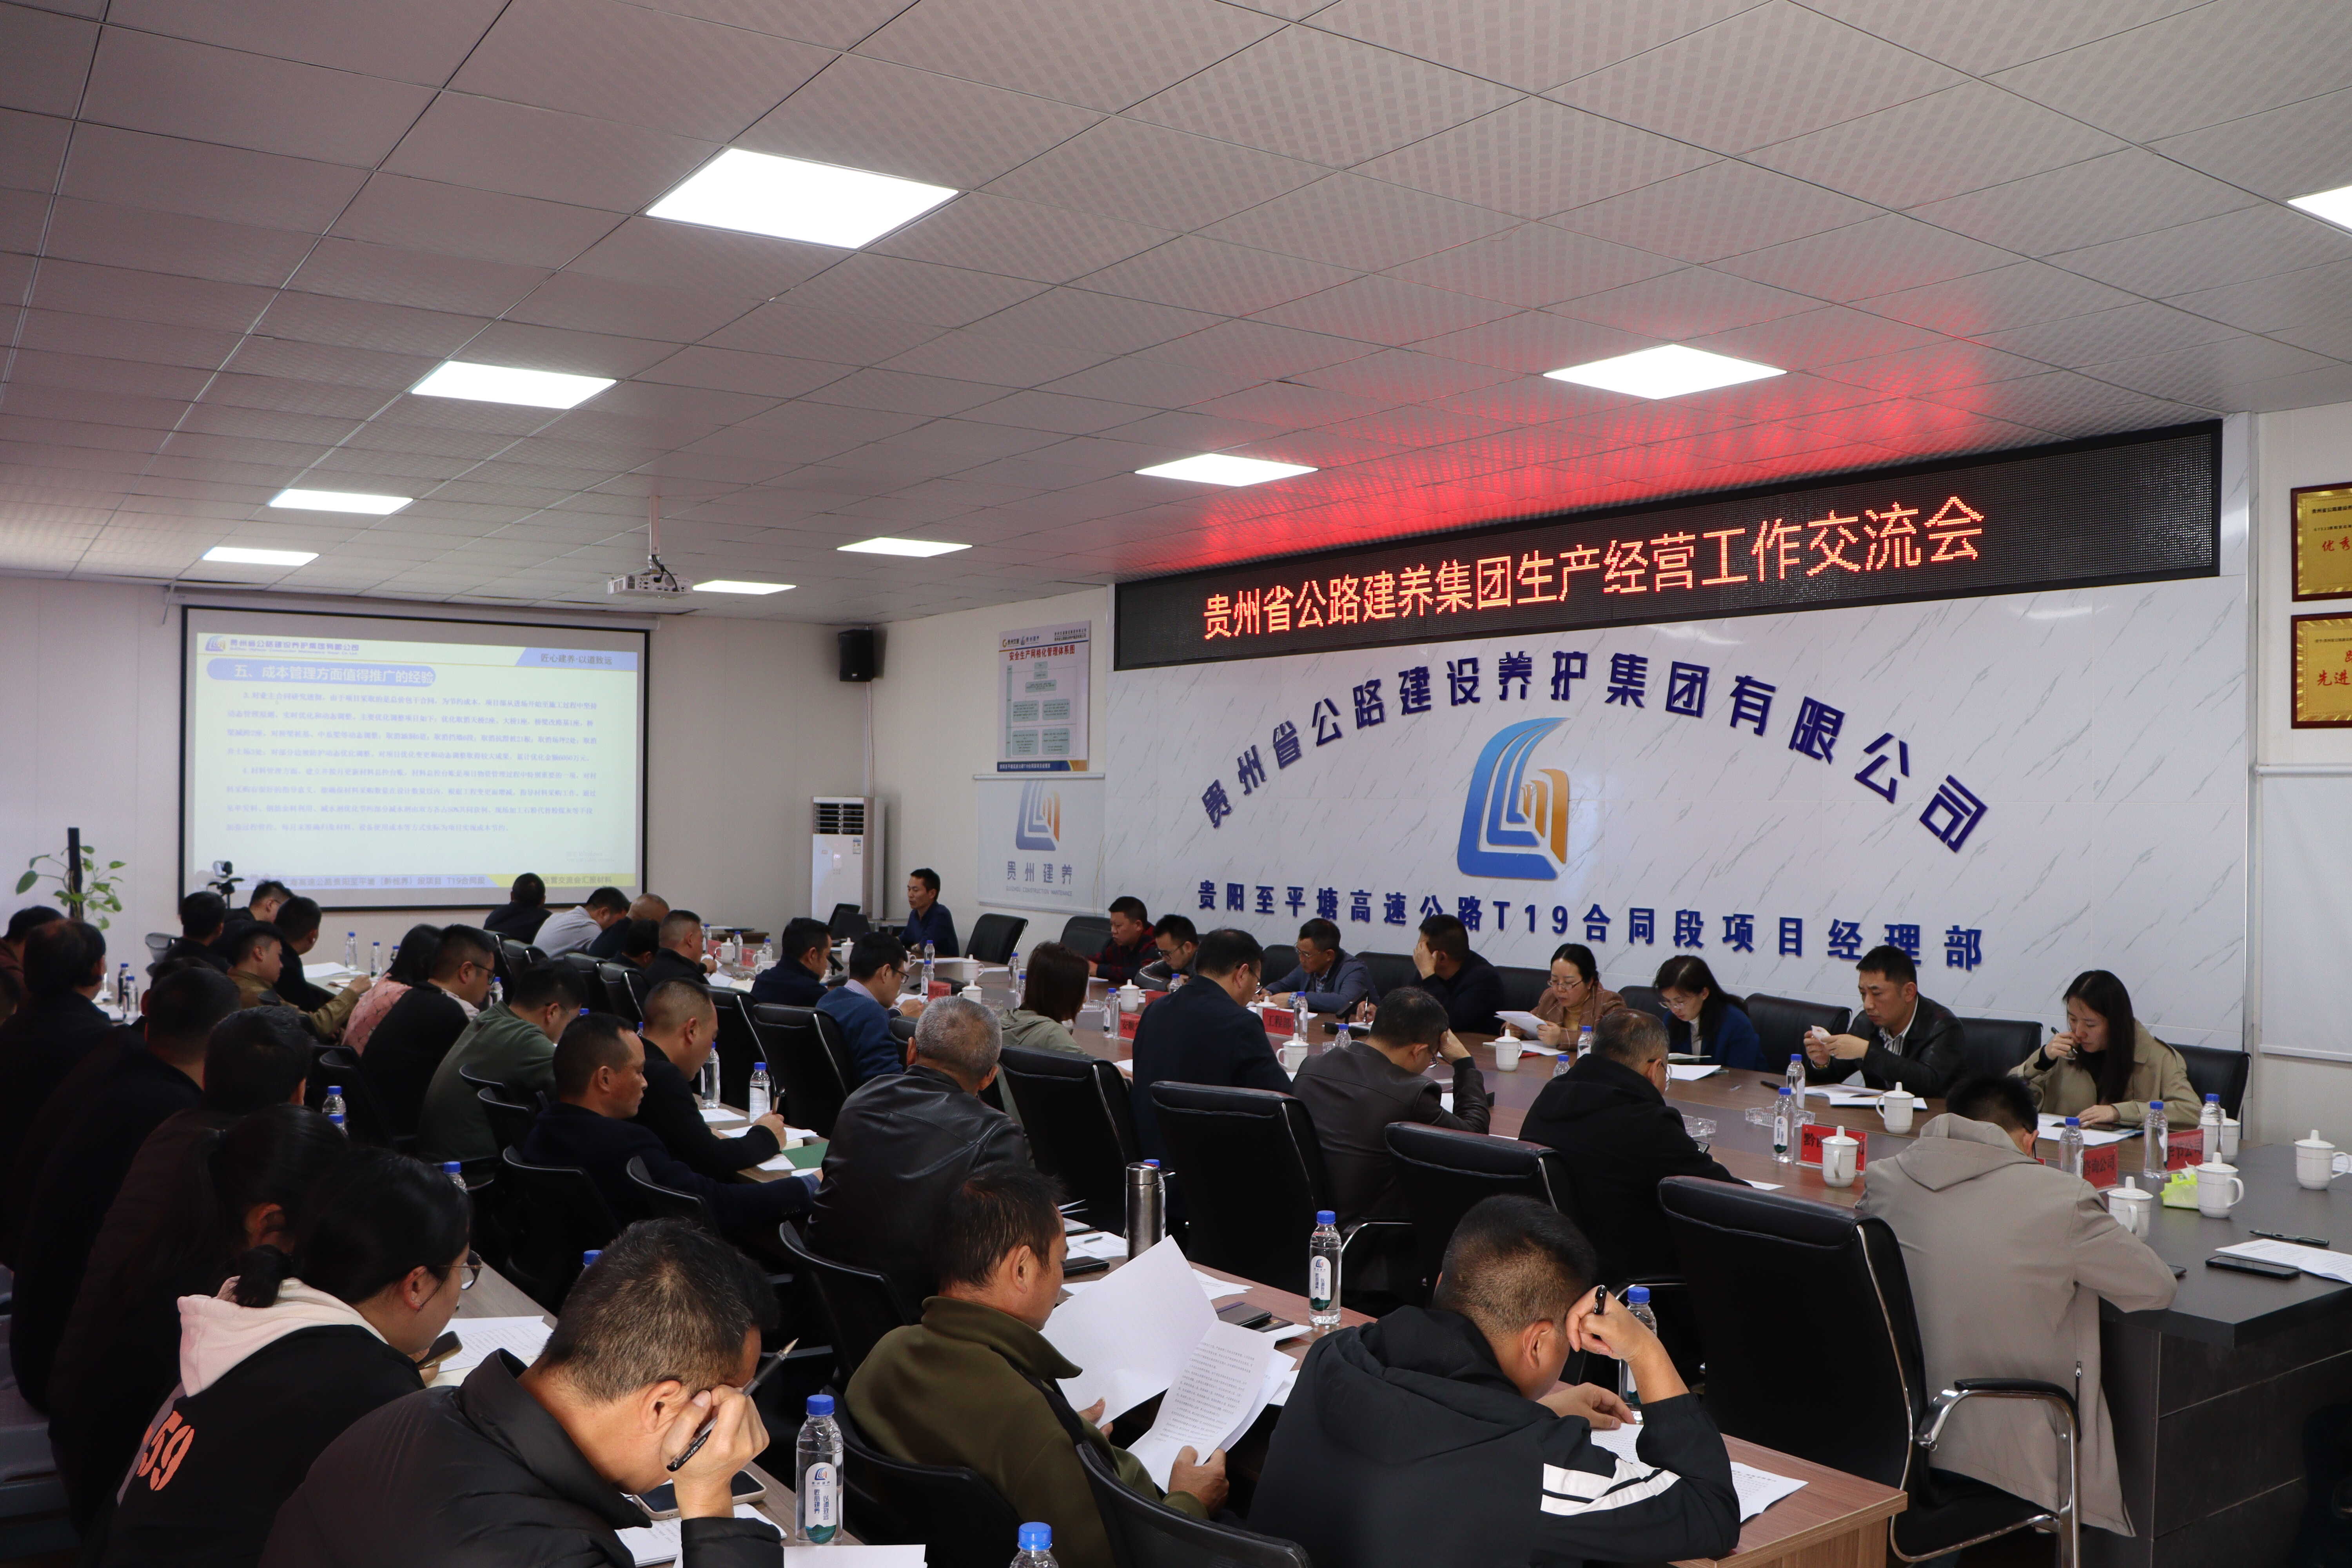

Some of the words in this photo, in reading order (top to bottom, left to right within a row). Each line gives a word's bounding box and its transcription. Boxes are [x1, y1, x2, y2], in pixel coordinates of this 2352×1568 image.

[1203, 496, 1984, 640] 贵州省公路建养集团生产经营工作交流会
[235, 664, 434, 684] 五、成本管理方面值得推广的经验
[1009, 644, 1075, 661] 安全生产网格化管理体系图
[1201, 651, 1988, 852] 贵州省公路建设养护集团有限公司
[1007, 861, 1072, 885] 贵州建养
[1198, 879, 1983, 971] 贵阳至平塘高速公路T19合同段项目经理部
